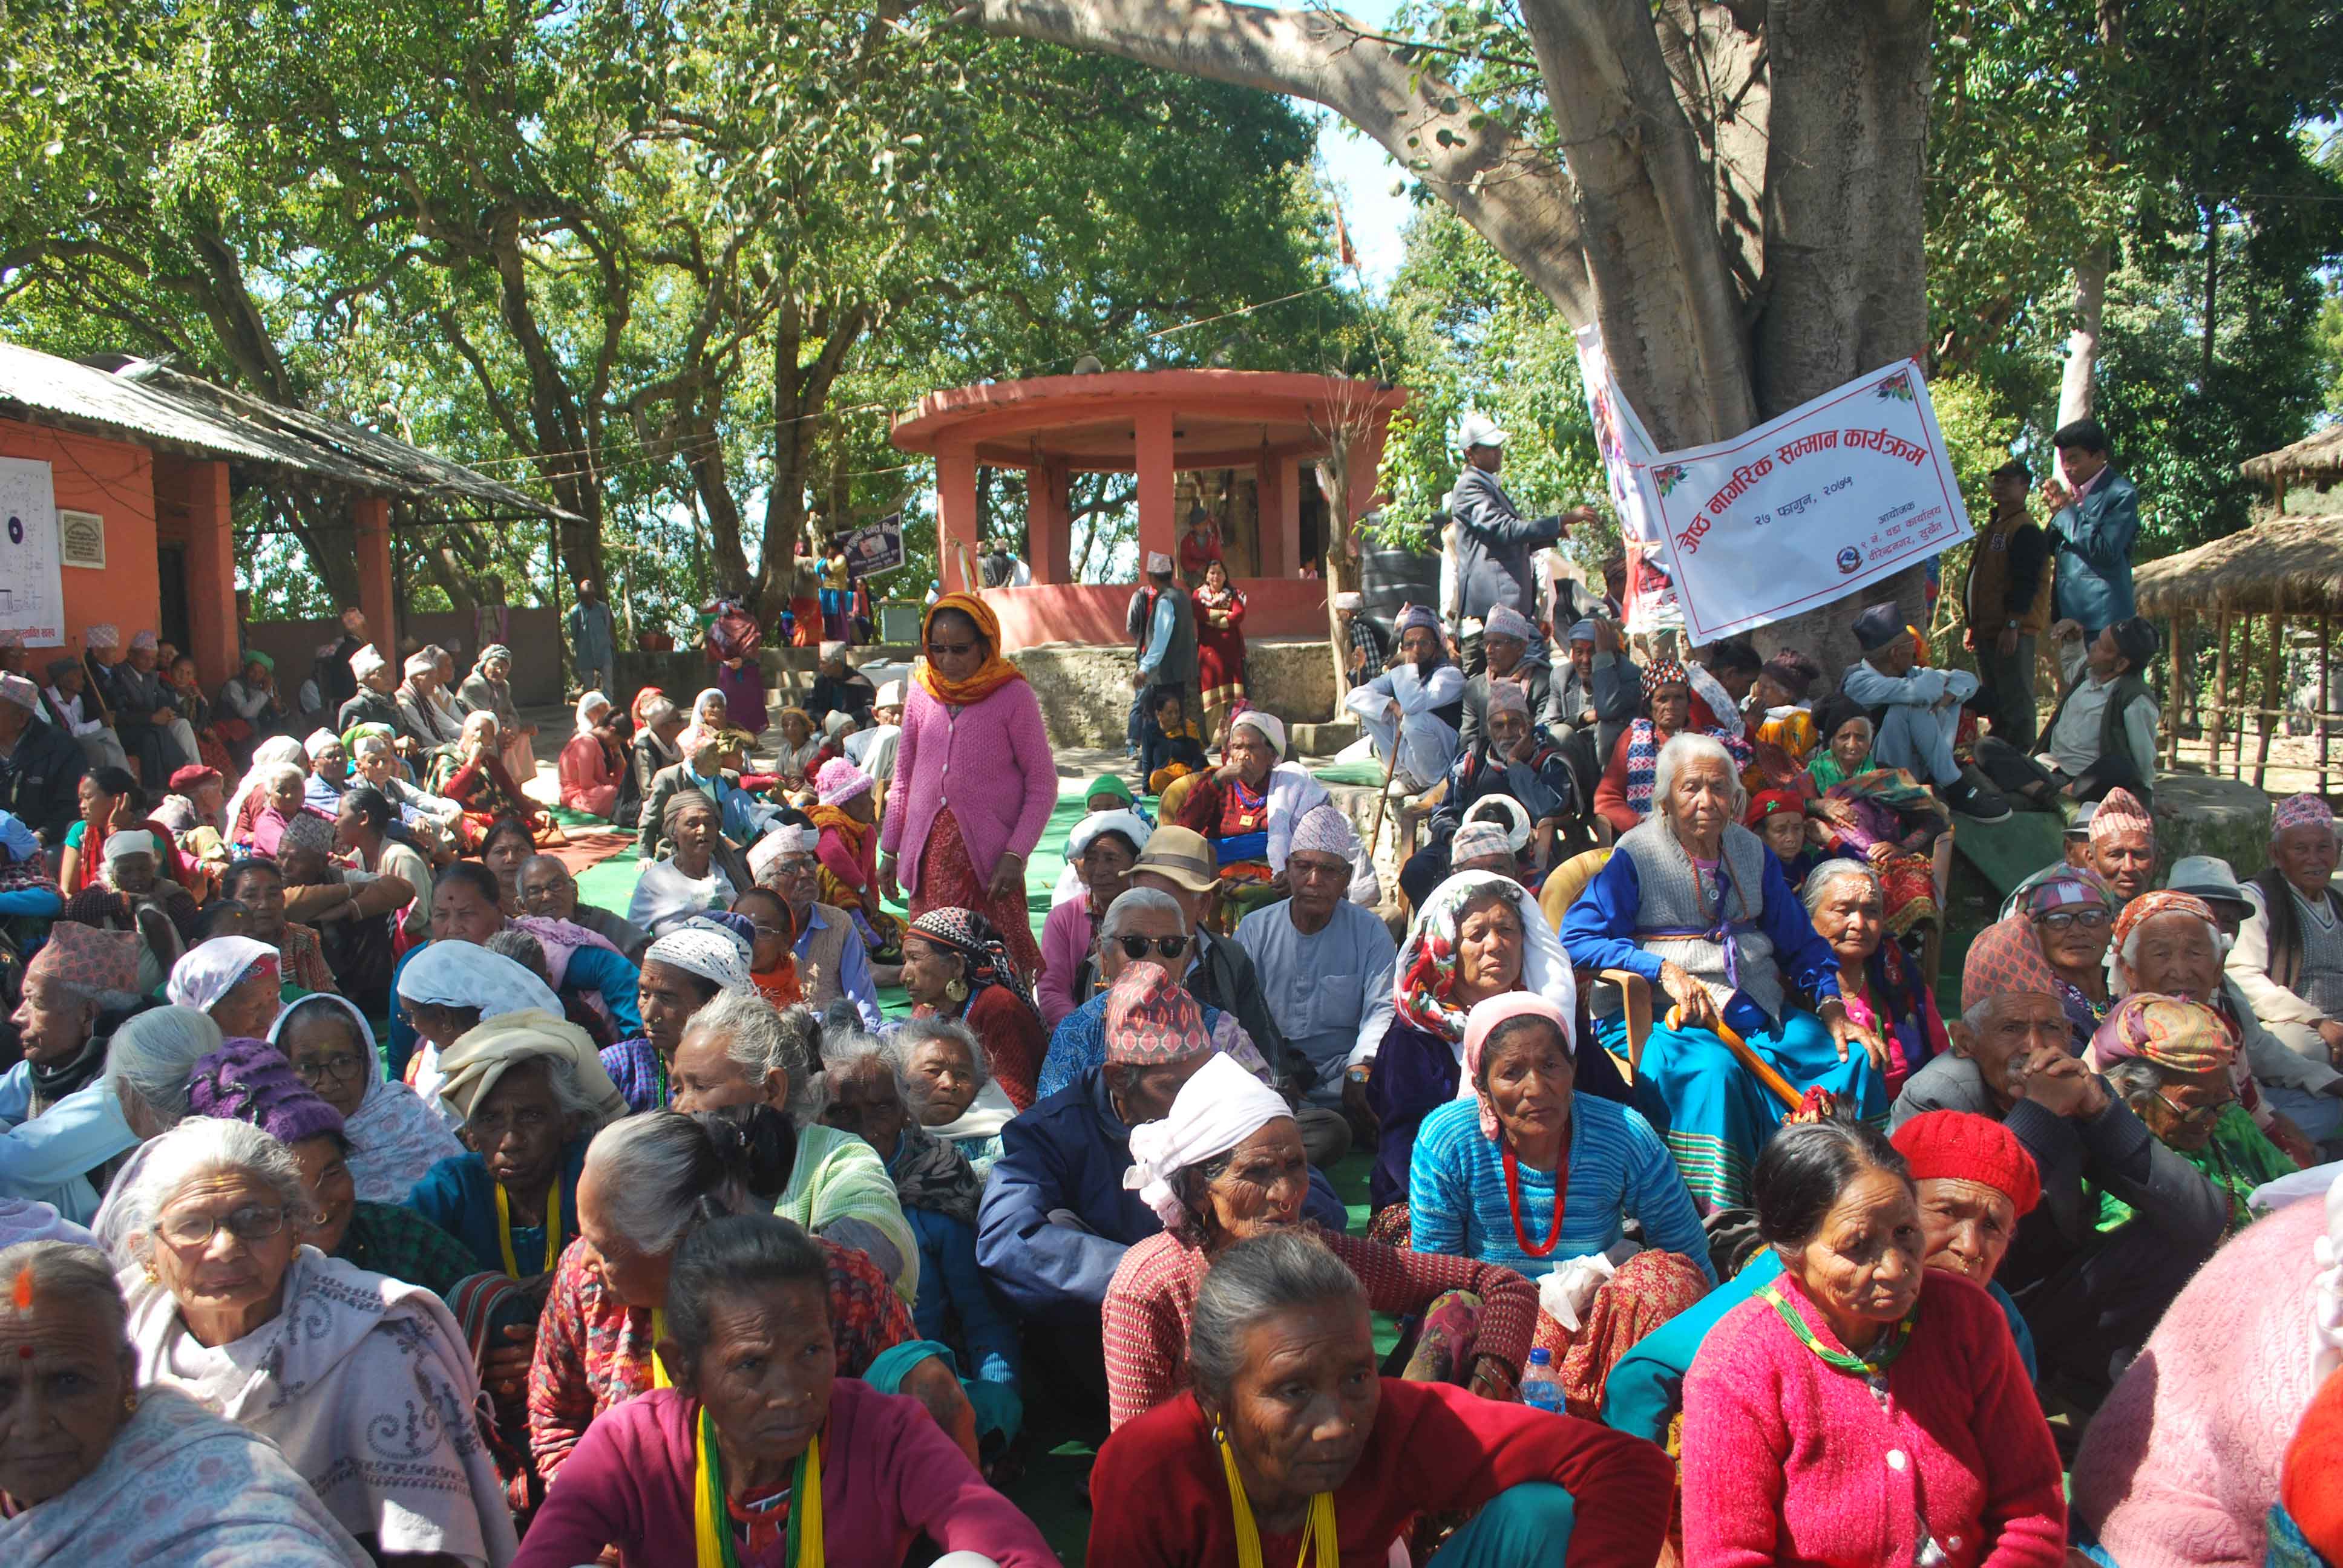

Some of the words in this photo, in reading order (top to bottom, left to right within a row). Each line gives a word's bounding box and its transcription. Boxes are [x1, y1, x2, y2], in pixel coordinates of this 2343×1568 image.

[1675, 511, 1711, 555] जेष्ठ
[1705, 454, 1773, 515] नागरिक
[1775, 430, 1840, 465] सम्मान
[1844, 428, 1928, 466] कार्यक्रम
[1754, 514, 1771, 525] २७
[1777, 493, 1817, 516] फागुन,
[1822, 475, 1853, 495] २०७५
[1878, 501, 1916, 524] आयोजक
[1904, 505, 1942, 528] कार्यालय
